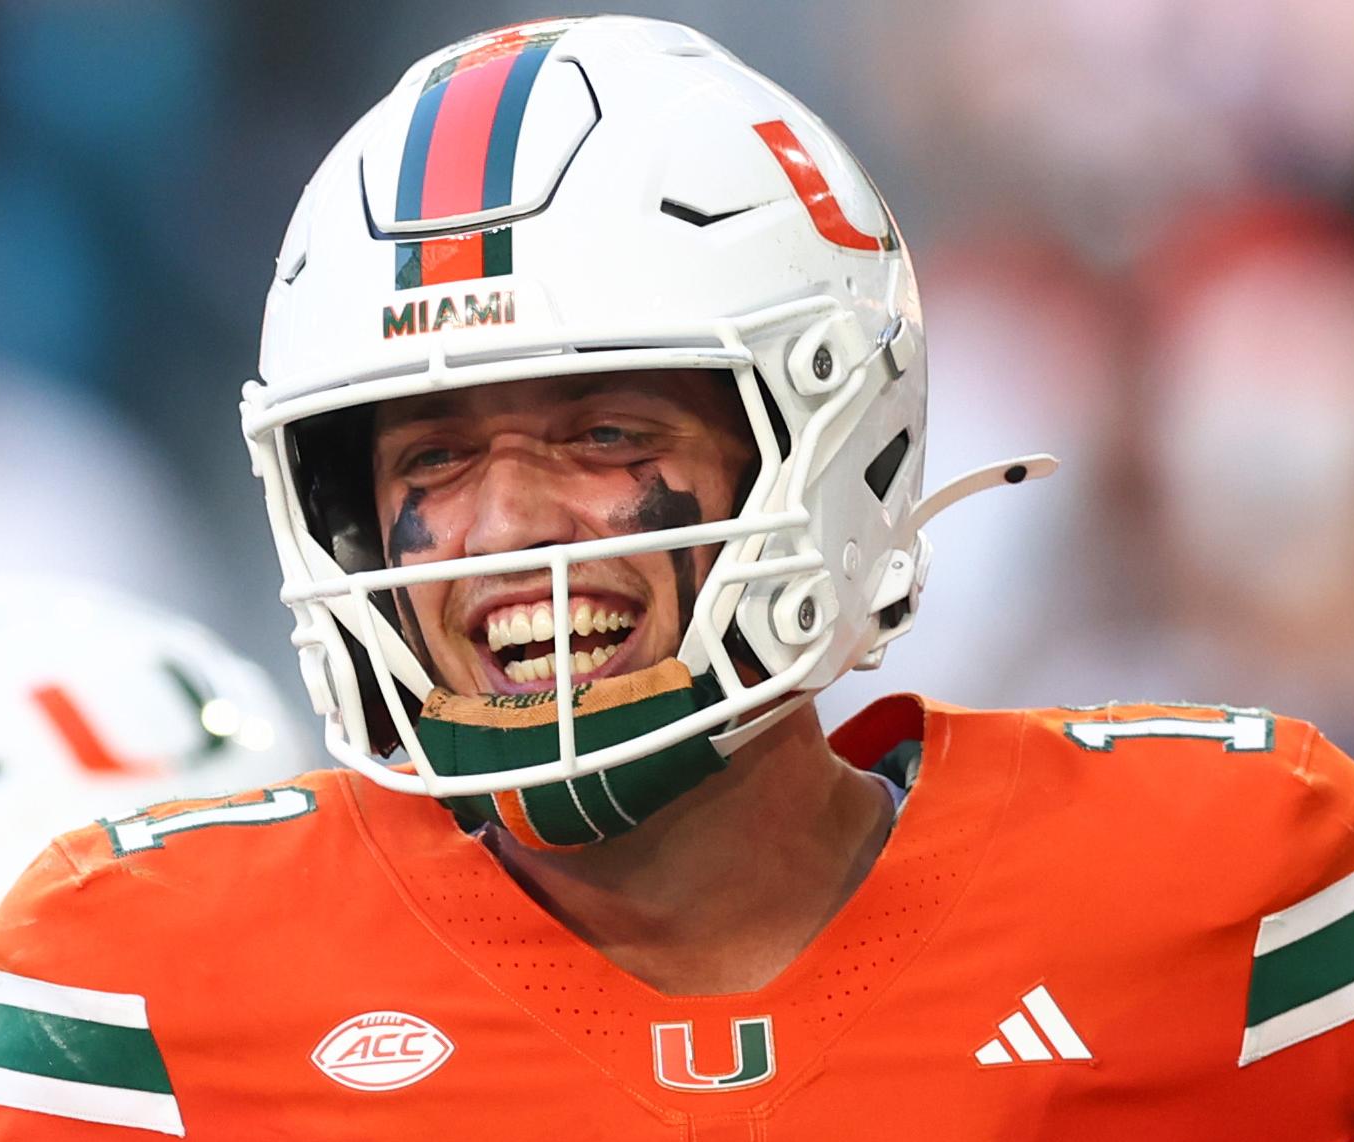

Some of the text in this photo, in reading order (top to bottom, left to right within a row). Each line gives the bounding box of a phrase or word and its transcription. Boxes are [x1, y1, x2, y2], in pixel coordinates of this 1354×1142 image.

[382, 290, 516, 340] MIAMI
[336, 1031, 428, 1062] ACC
[651, 1014, 777, 1094] U
